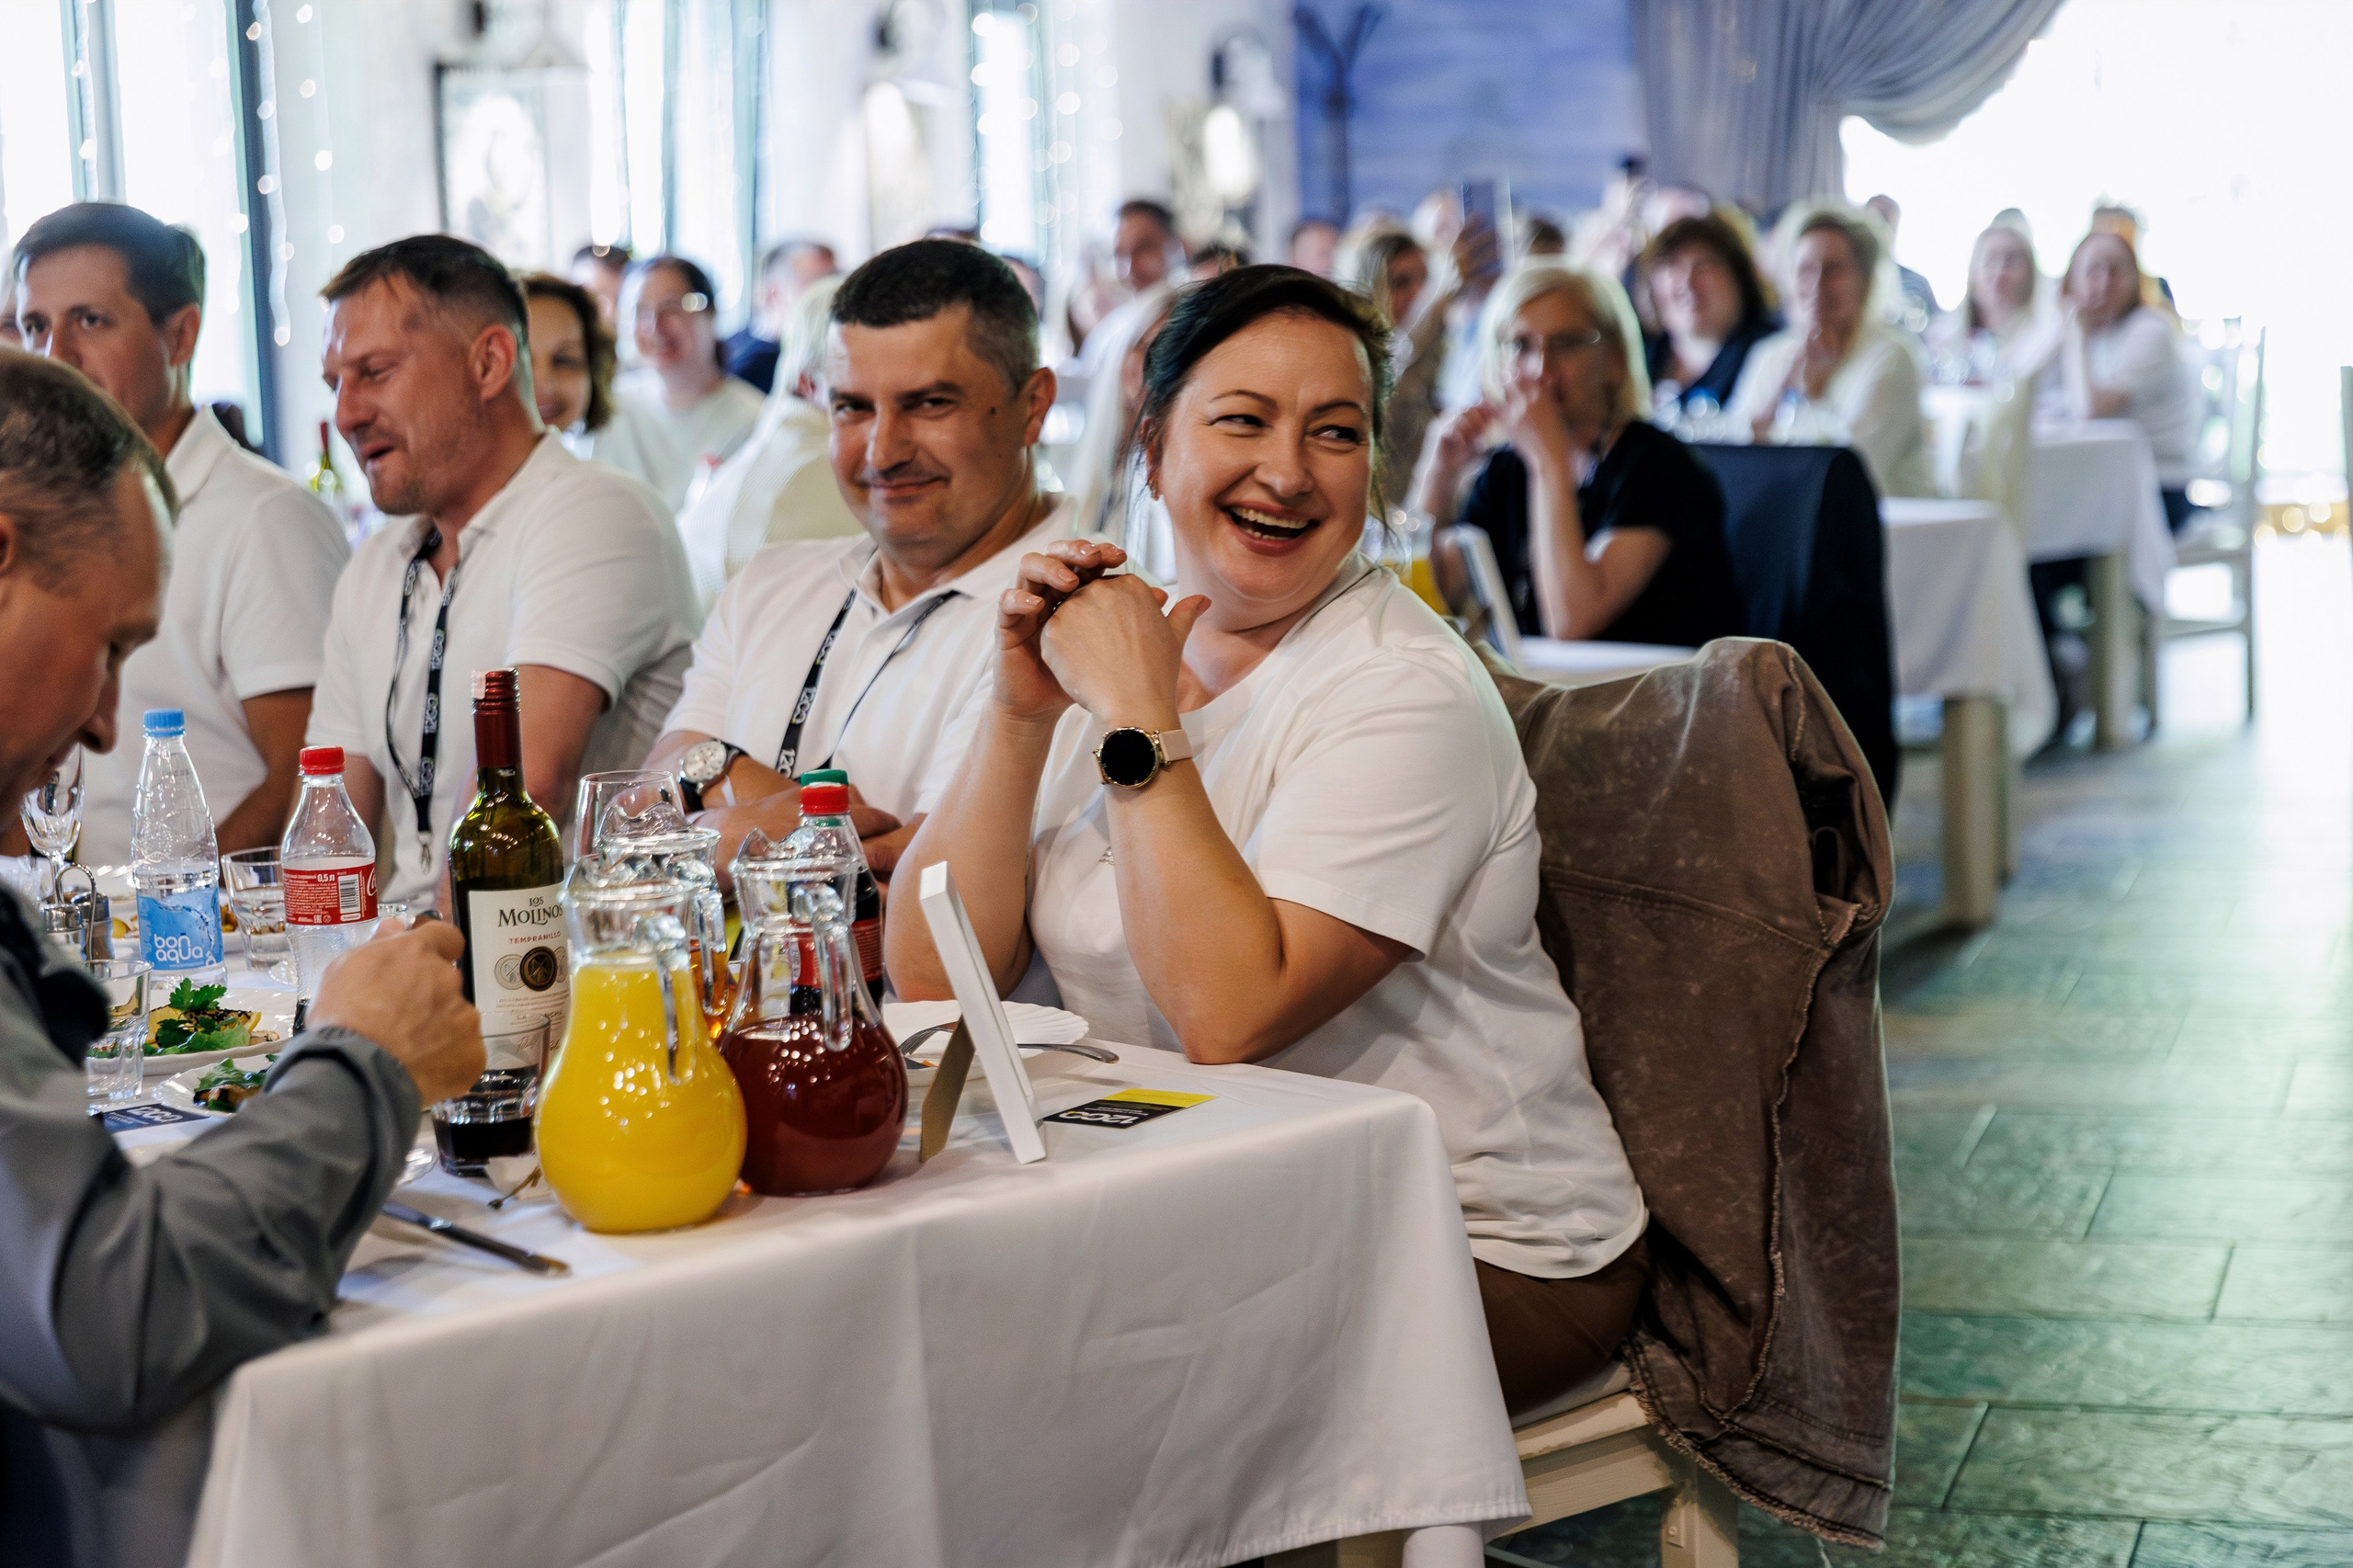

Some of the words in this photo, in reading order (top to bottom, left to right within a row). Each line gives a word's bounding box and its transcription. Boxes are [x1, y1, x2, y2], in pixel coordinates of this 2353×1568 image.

[317, 873, 329, 883] 0,5
[529, 896, 544, 907] LOS
[498, 903, 563, 927] MOLINOS
[153, 933, 191, 949] bon
[509, 930, 562, 945] TEMPRANILLO
[155, 946, 204, 964] aqua
